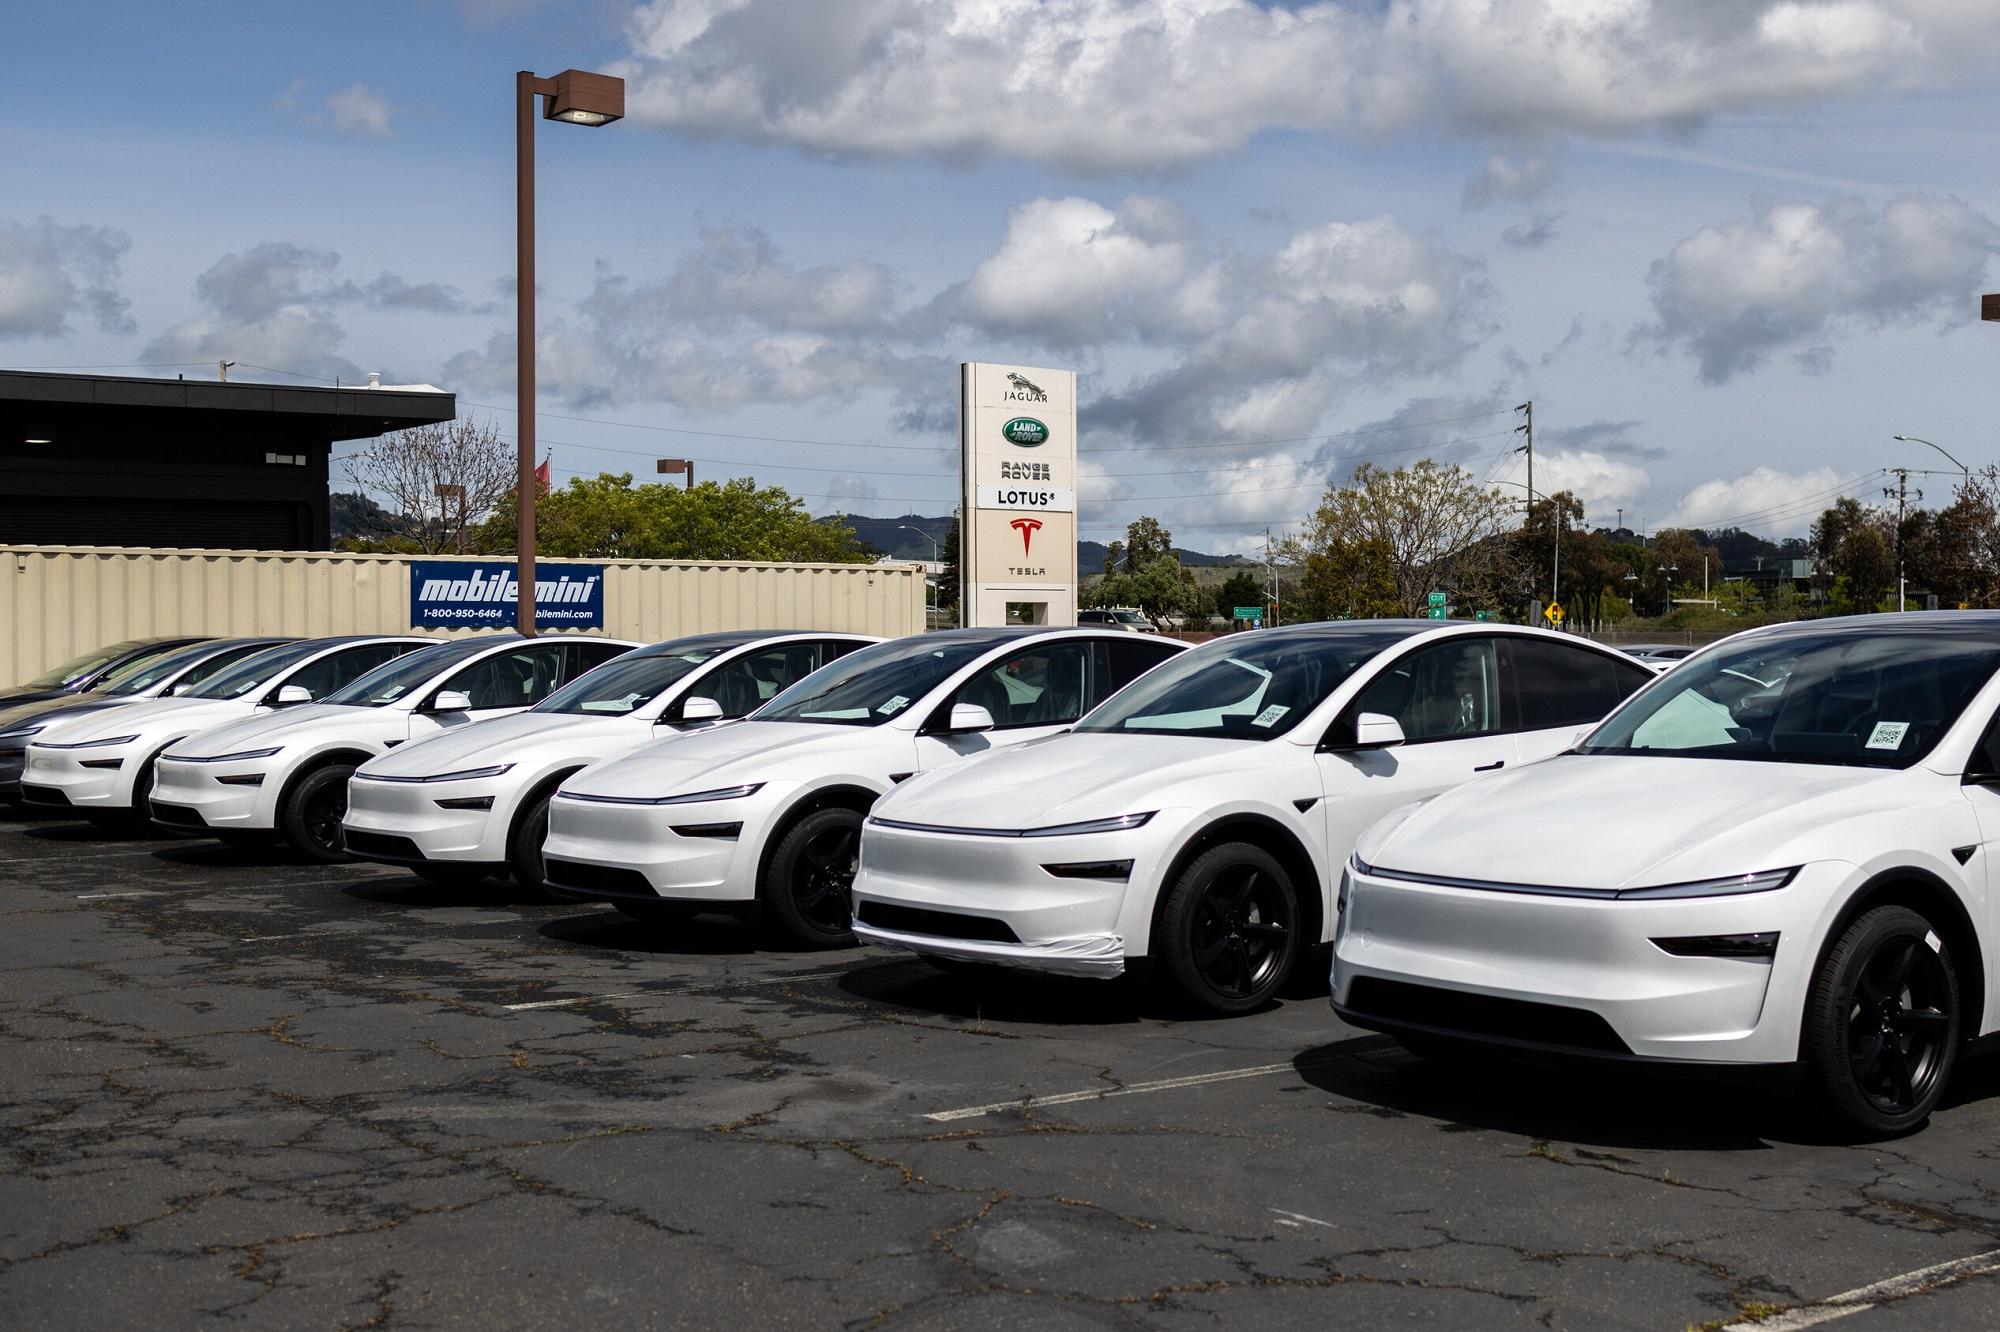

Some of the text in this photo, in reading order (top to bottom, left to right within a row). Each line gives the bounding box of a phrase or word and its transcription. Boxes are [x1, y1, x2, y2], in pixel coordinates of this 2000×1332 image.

[1004, 391, 1048, 403] JAGUAR
[1013, 422, 1036, 432] LAND
[1015, 432, 1043, 442] ROVER
[1001, 461, 1050, 472] RANGE
[1001, 471, 1051, 481] ROVER
[998, 490, 1048, 505] LOTUS
[1008, 567, 1046, 576] TESLA
[423, 608, 593, 619] 1-800-950-6464 bilemini.com
